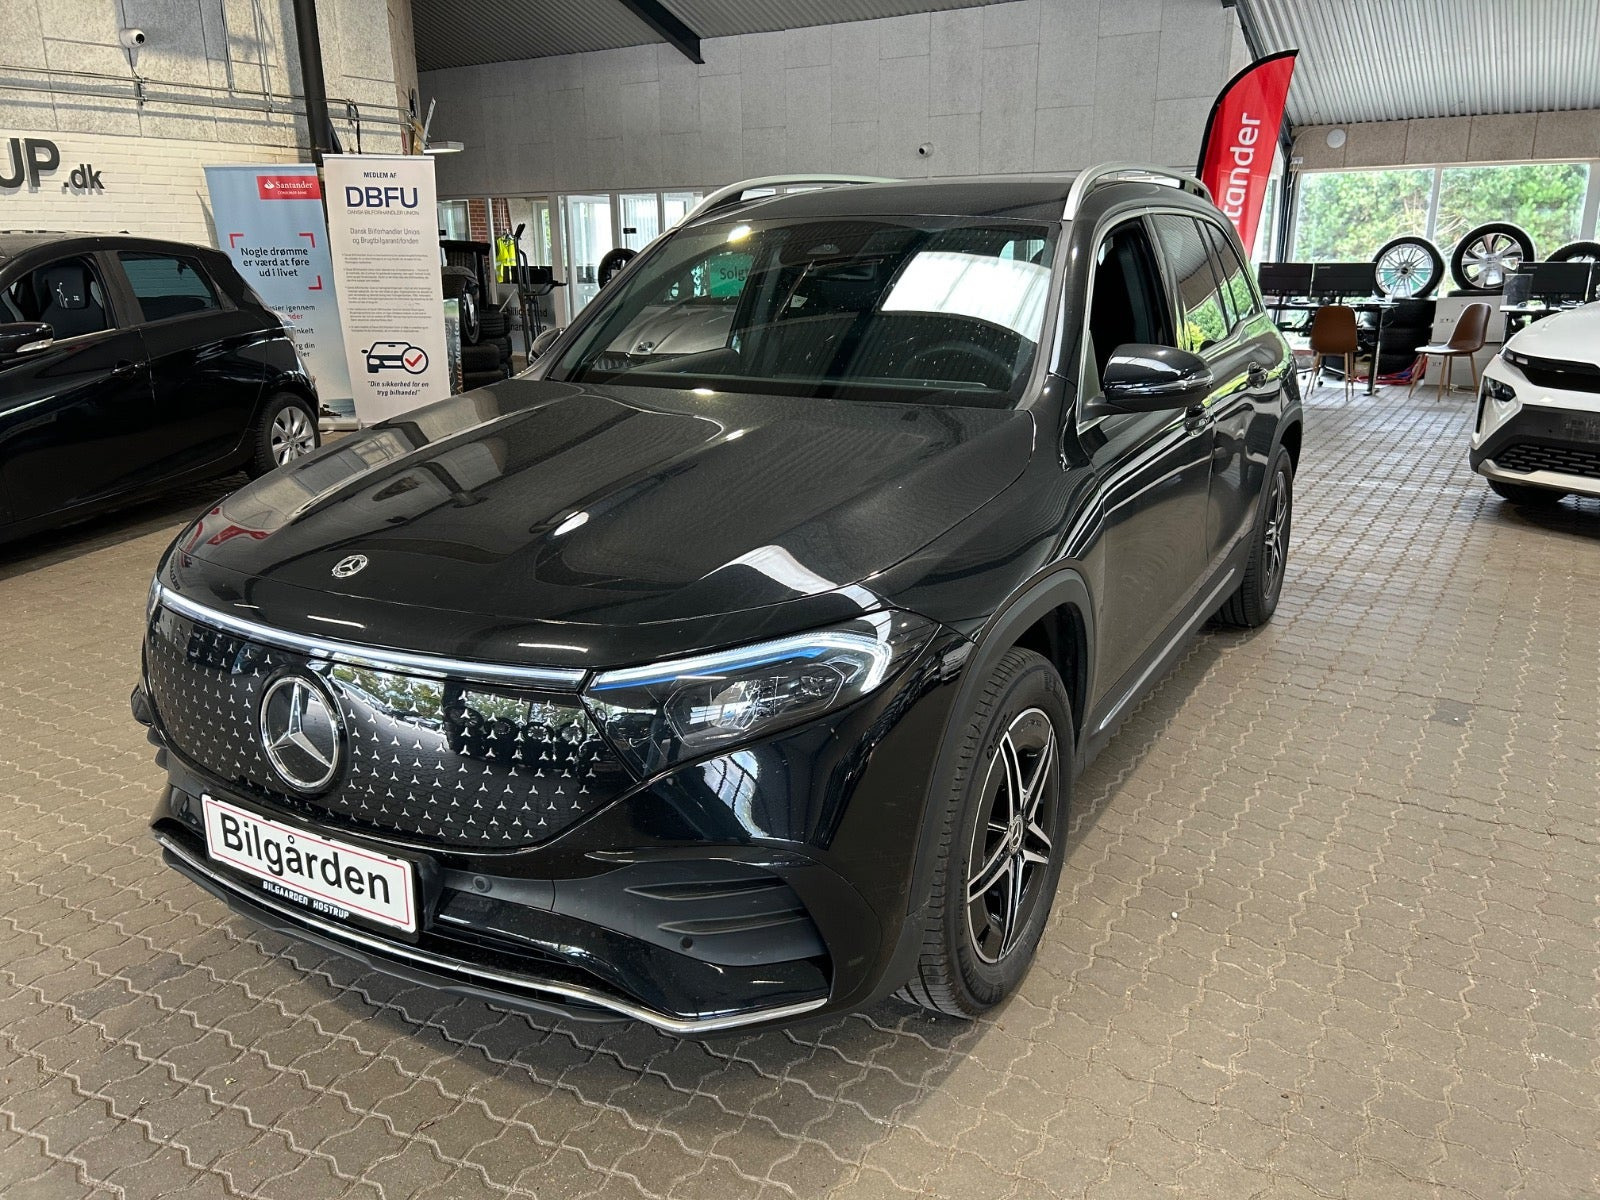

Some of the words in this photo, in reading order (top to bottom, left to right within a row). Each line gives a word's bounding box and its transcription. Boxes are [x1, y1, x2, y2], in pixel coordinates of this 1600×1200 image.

[363, 171, 388, 179] MEDLEM
[275, 180, 313, 189] Santander
[345, 186, 418, 209] DBFU
[240, 247, 268, 258] Nogle
[270, 247, 308, 256] drømme
[243, 259, 253, 267] er
[254, 257, 278, 267] værd
[279, 258, 290, 267] at
[291, 257, 310, 266] føre
[259, 268, 271, 277] ud
[272, 269, 276, 277] i
[277, 268, 298, 277] livet
[285, 304, 316, 313] igennem
[381, 380, 411, 388] sikkerhed
[220, 811, 391, 905] Bilgården
[262, 879, 309, 906] BILGAARDEN
[312, 900, 350, 920] HOSTRUP
